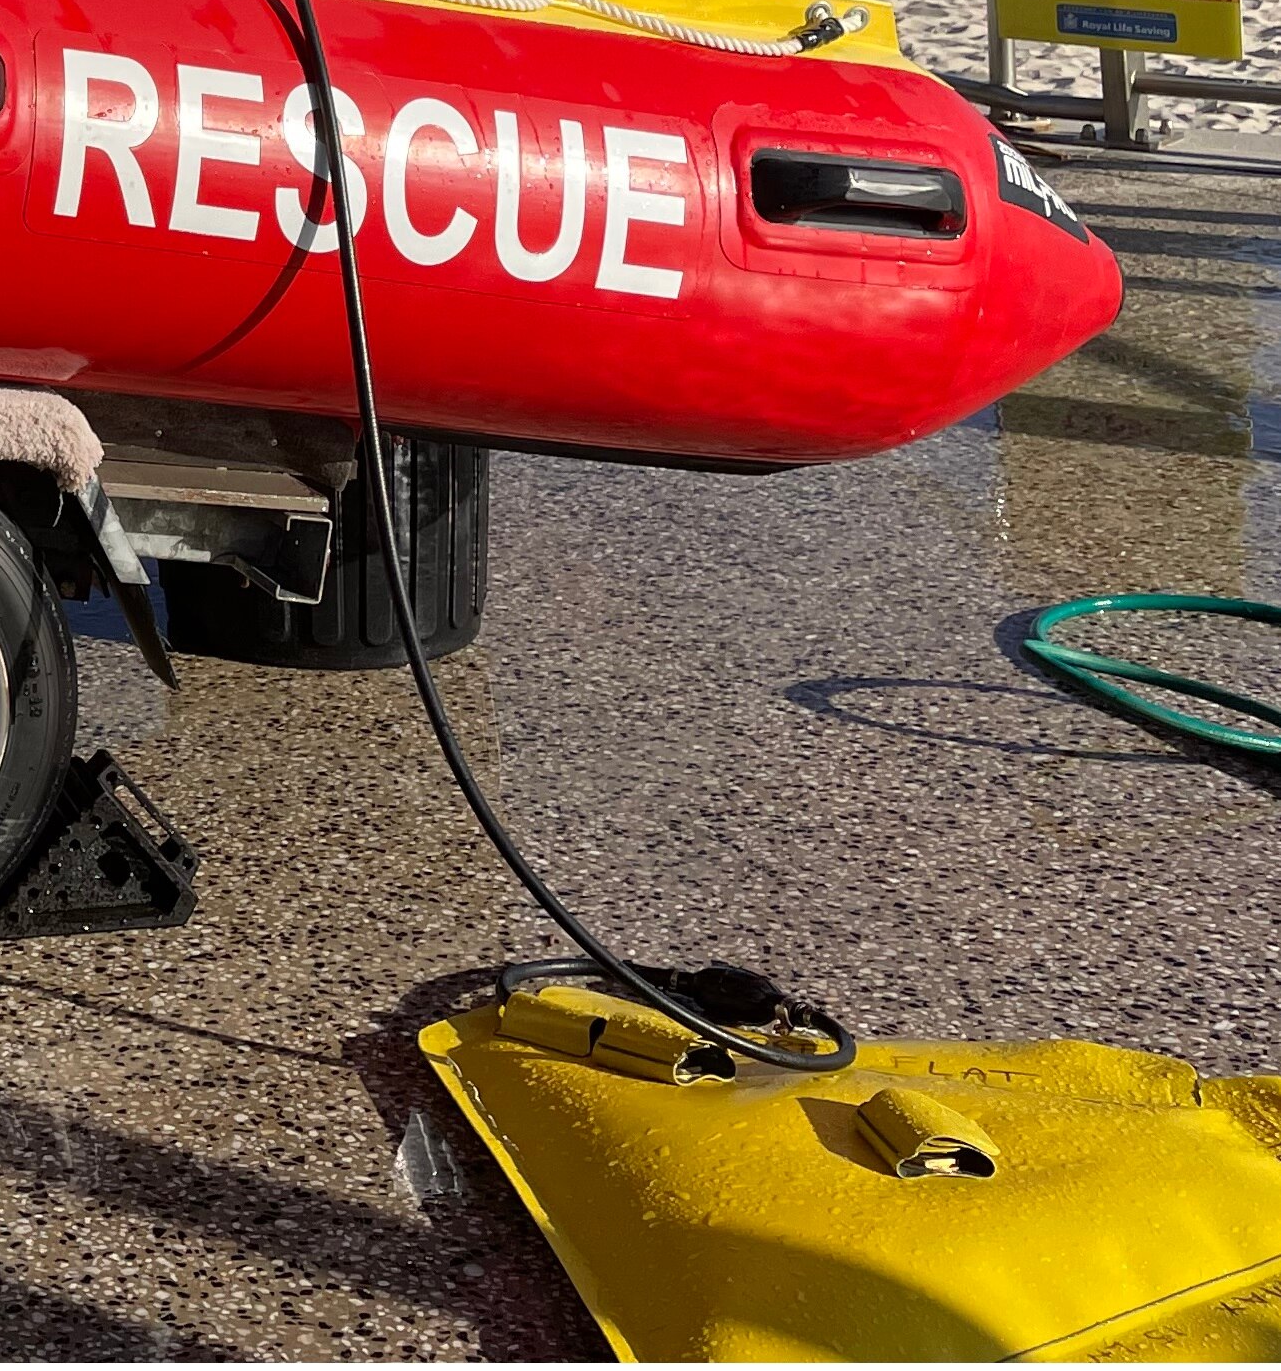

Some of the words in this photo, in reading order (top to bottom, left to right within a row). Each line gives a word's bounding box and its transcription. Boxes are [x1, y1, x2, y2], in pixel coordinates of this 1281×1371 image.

[1082, 19, 1112, 32] Royal
[1112, 22, 1133, 34] Life
[1134, 24, 1171, 39] Saving
[53, 48, 688, 299] RESCUE
[891, 1055, 1039, 1085] FLAT
